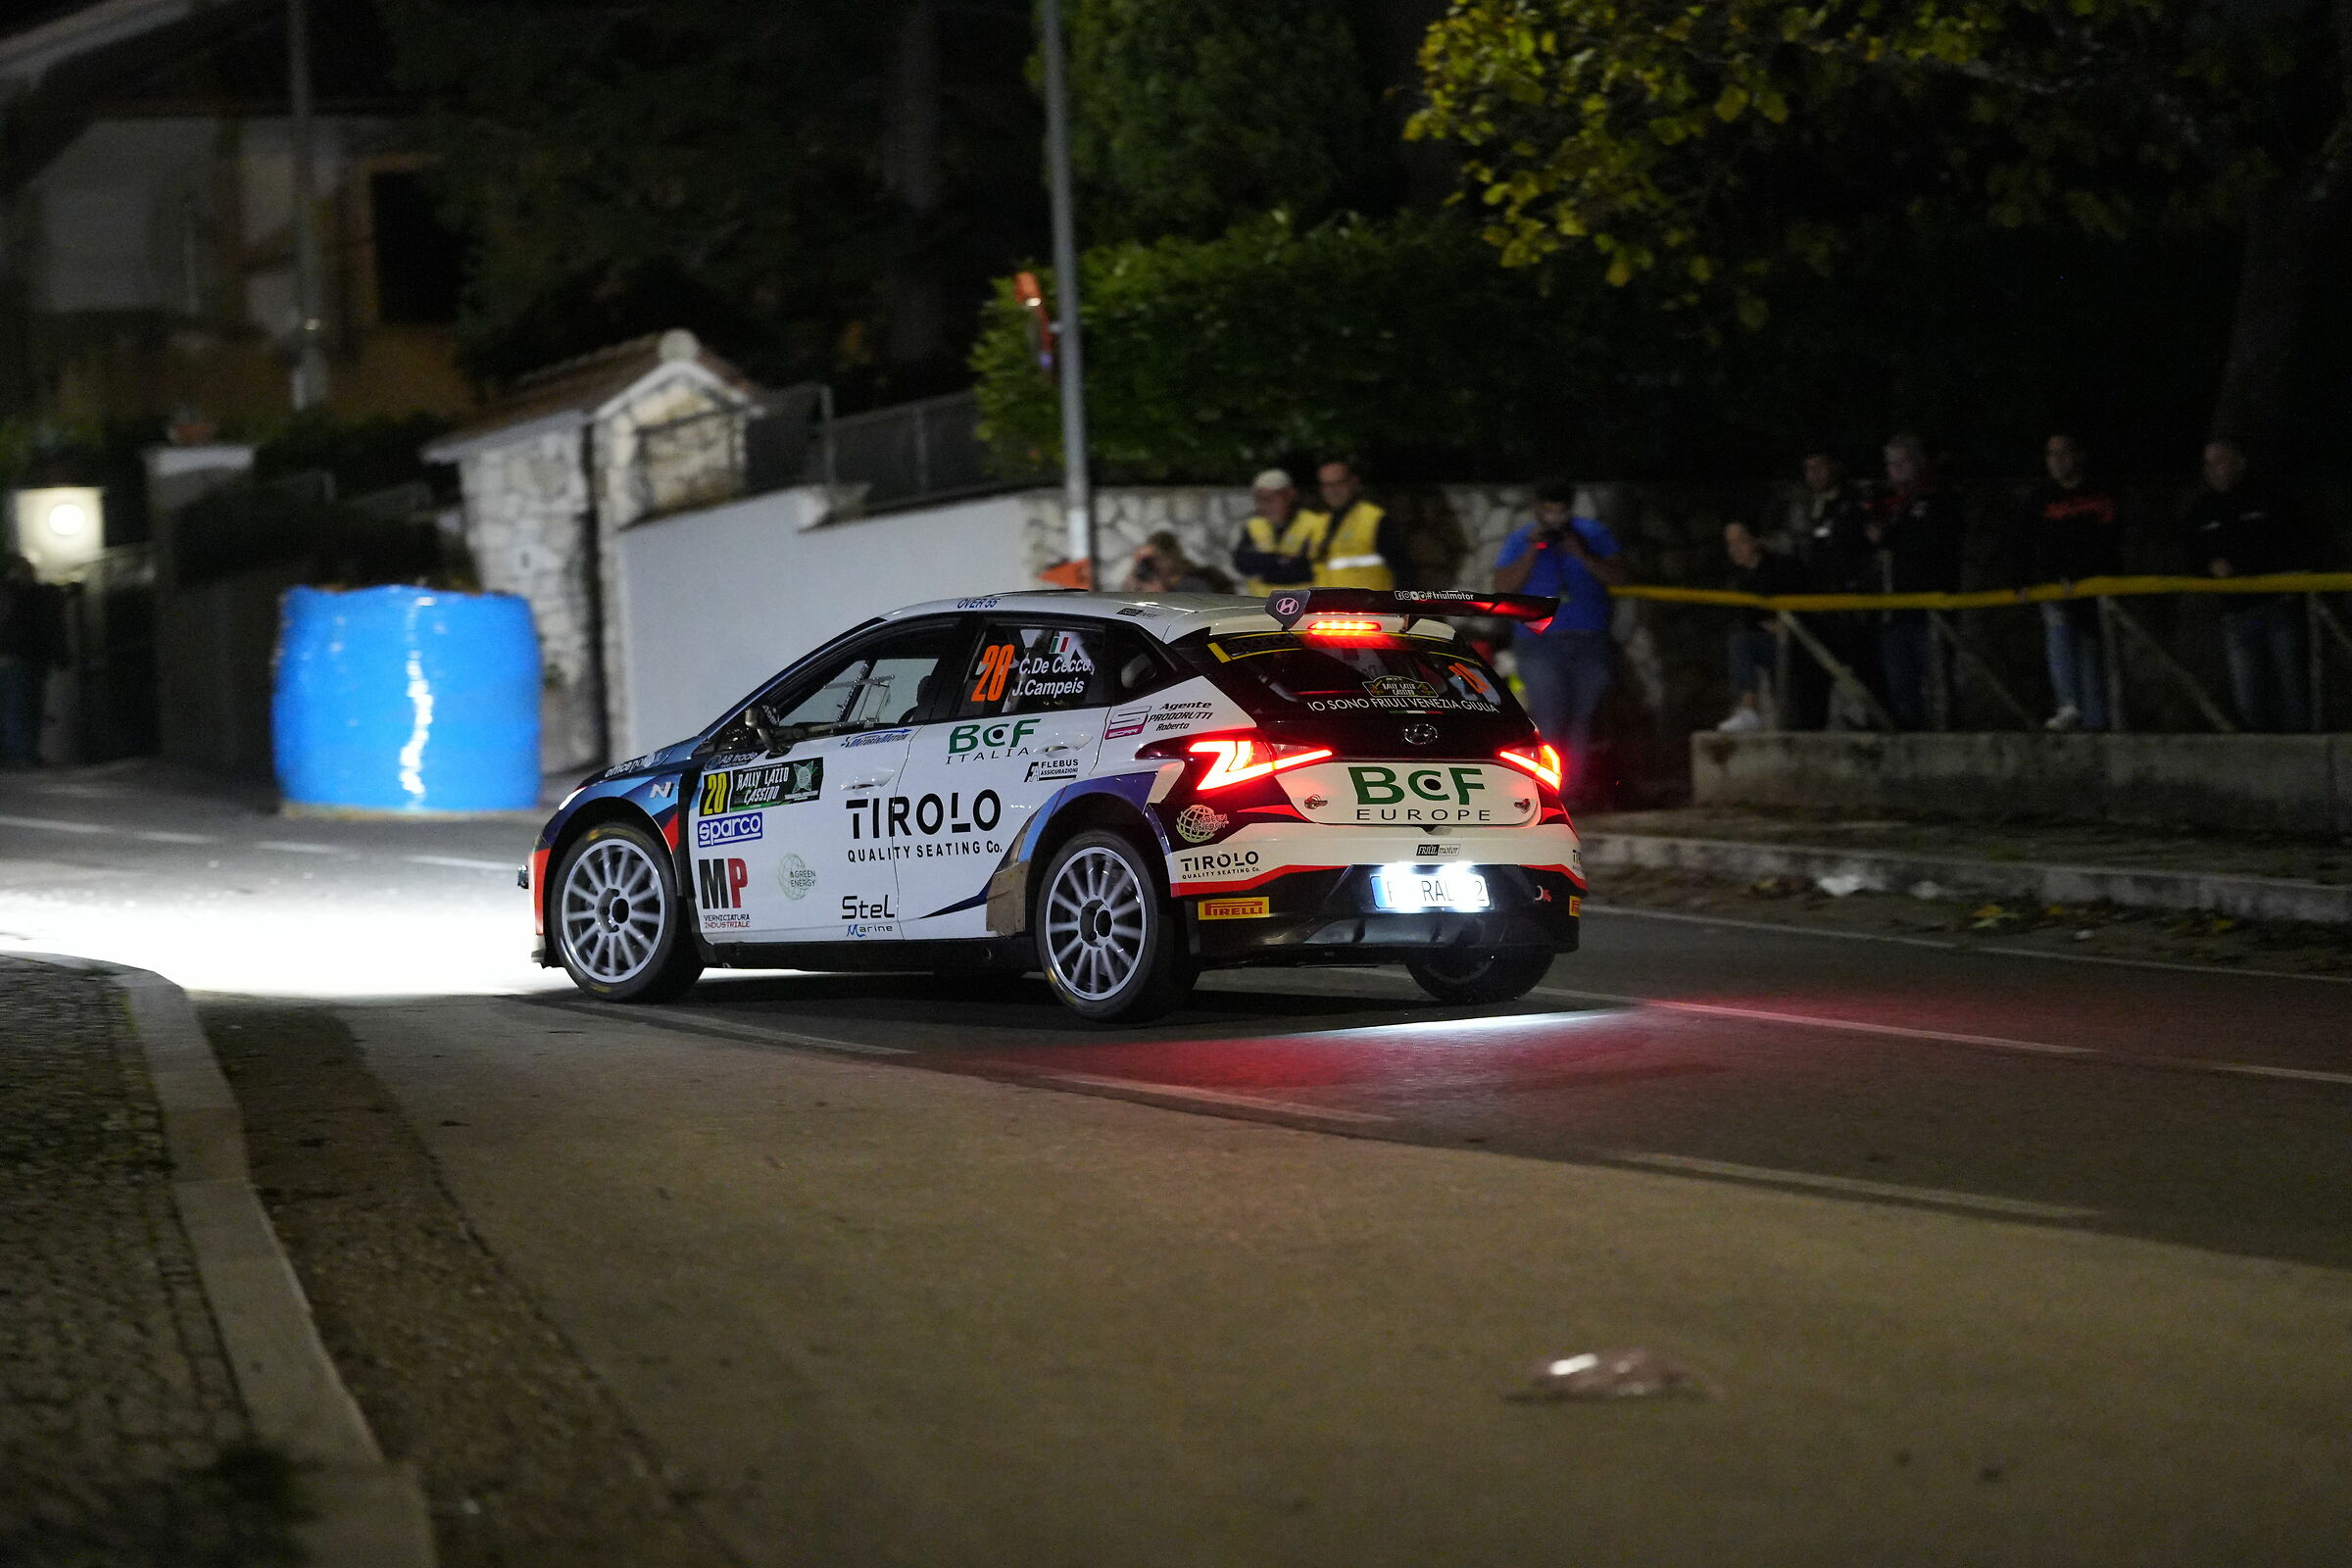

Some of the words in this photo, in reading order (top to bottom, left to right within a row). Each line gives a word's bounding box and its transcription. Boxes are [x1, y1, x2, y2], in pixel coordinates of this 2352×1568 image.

[956, 598, 984, 609] OVER
[1011, 677, 1084, 698] J.Campeis
[1159, 701, 1212, 711] Agente
[1306, 701, 1326, 711] IO
[1327, 698, 1370, 710] SONO
[1370, 697, 1407, 709] FRIULI
[1407, 697, 1461, 710] VENEZIA
[1461, 700, 1501, 713] GIULIA
[1155, 722, 1190, 731] Roberto
[949, 718, 1041, 754] BCF
[945, 747, 1029, 764] ITALIA
[1041, 759, 1079, 769] FLEBUS
[736, 769, 761, 792] RALLY
[764, 766, 790, 787] LAZIO
[1348, 766, 1485, 806] BCF
[703, 772, 727, 815] 20
[846, 789, 1001, 840] TIROLO
[1356, 808, 1490, 821] EUROPE
[699, 814, 761, 845] sparco
[848, 845, 910, 862] QUALITY
[916, 841, 980, 858] SEATING
[986, 840, 1003, 854] Co.
[1180, 851, 1259, 872] TIROLO
[699, 858, 748, 909] MP
[1182, 871, 1214, 880] QUALITY
[1204, 901, 1264, 916] PIRELLI
[703, 913, 751, 922] VERNICIATURA
[704, 920, 751, 929] INDUSTRIALE
[847, 924, 893, 937] Marine
